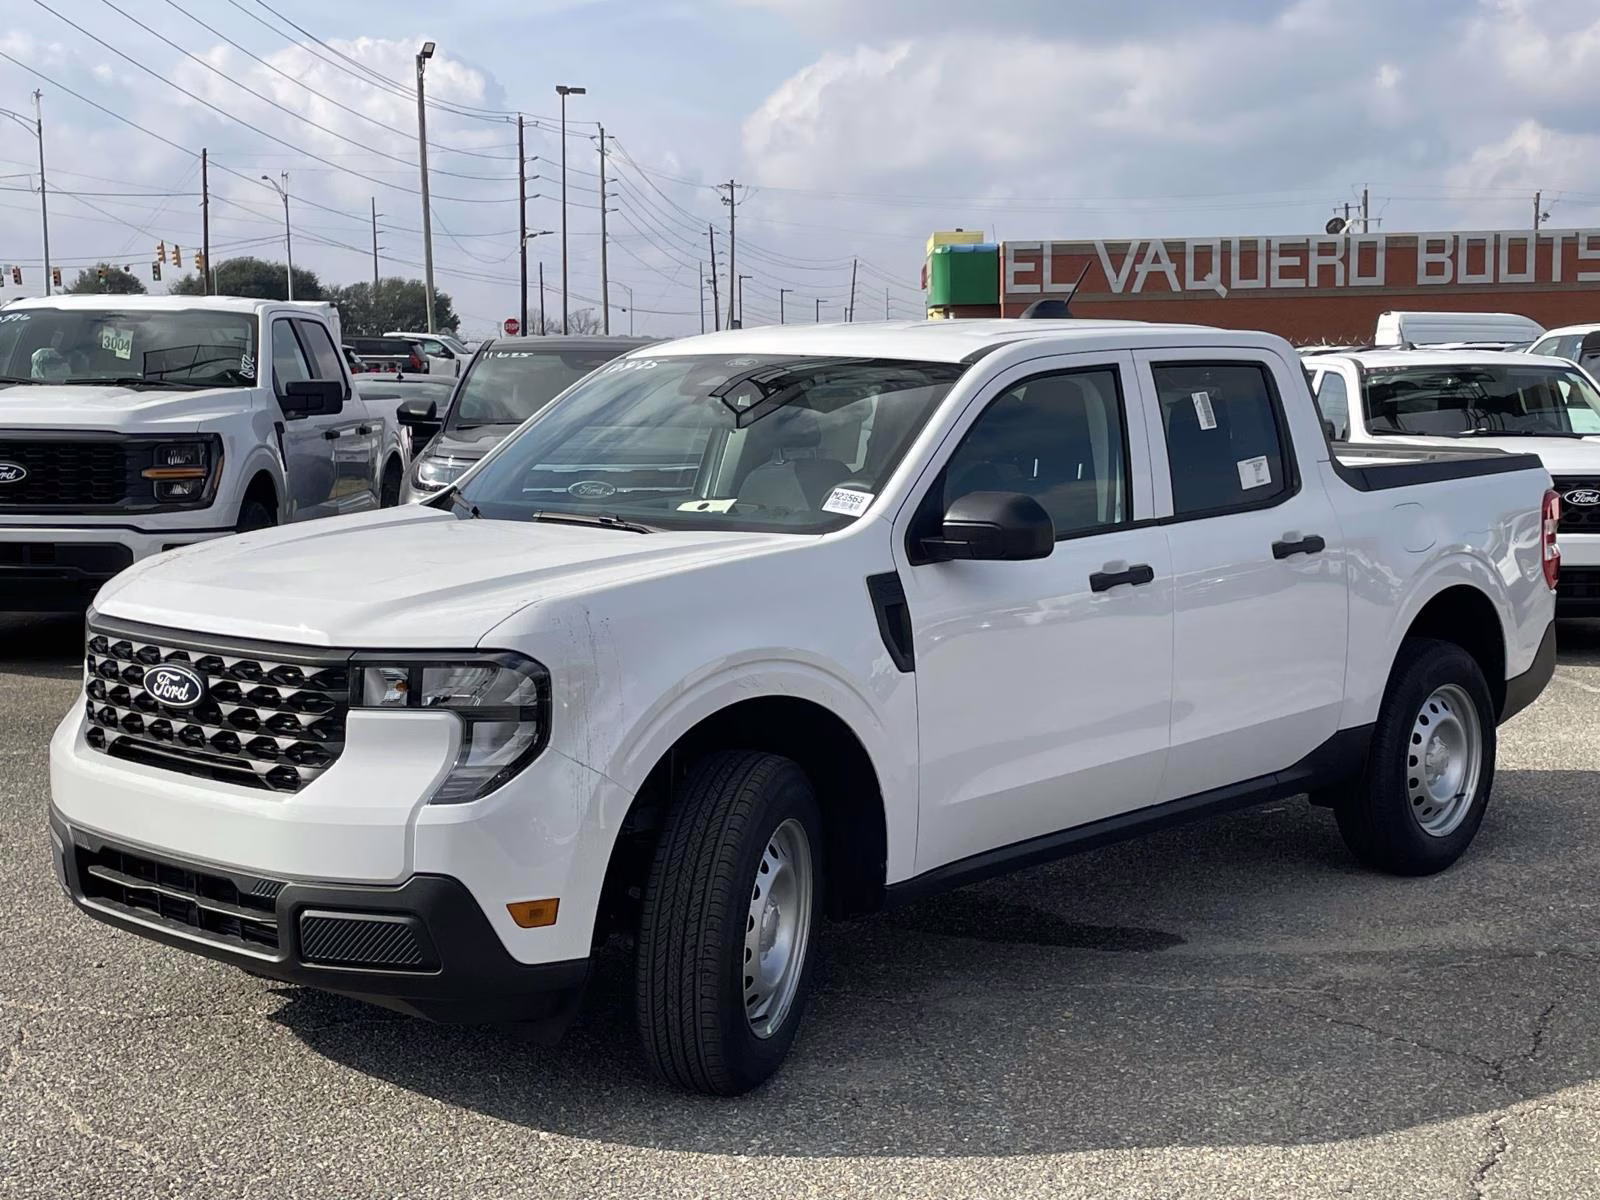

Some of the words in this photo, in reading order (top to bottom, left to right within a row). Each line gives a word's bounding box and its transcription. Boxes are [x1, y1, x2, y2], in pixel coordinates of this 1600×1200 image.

[1005, 240, 1078, 293] EL
[1094, 234, 1385, 298] VAQUERO
[1417, 229, 1600, 285] BOOTS
[505, 322, 519, 331] STOP
[104, 336, 130, 352] 3004
[0, 466, 17, 480] rd
[832, 491, 864, 504] M23563
[1572, 491, 1600, 503] Ford
[153, 671, 190, 701] Ford
